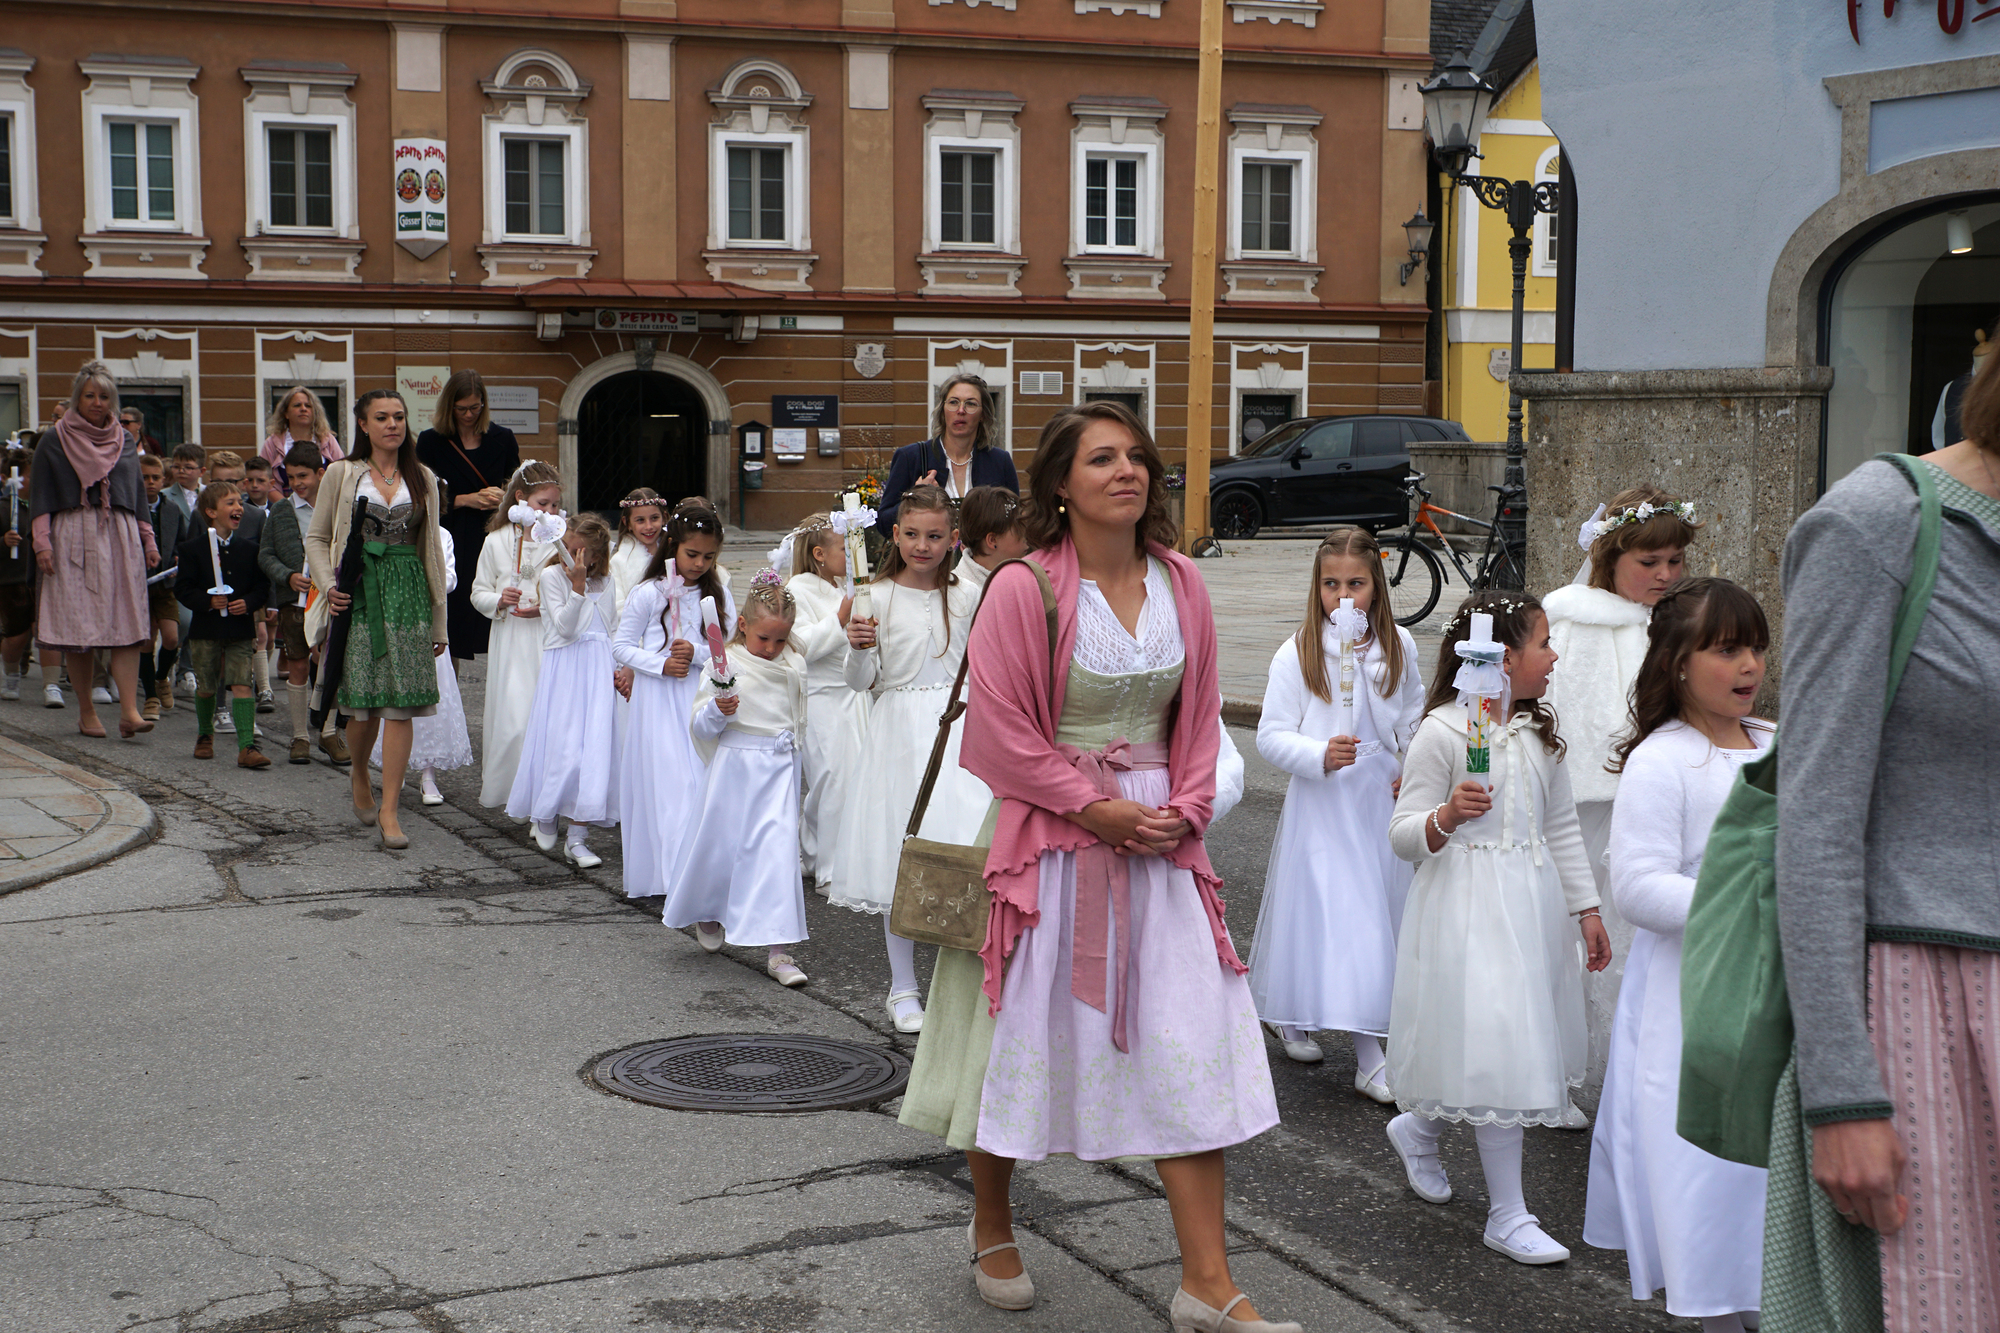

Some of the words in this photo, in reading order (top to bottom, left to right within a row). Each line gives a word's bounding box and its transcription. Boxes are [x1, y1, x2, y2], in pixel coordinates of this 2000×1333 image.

[395, 145, 422, 162] PEPITO
[424, 145, 446, 163] PEPITO
[399, 214, 421, 228] Gösser
[426, 214, 445, 228] Gösser
[620, 312, 678, 324] PEPITO
[784, 317, 794, 325] 12
[400, 378, 432, 391] Natur
[431, 375, 444, 390] &
[417, 386, 442, 396] mehr
